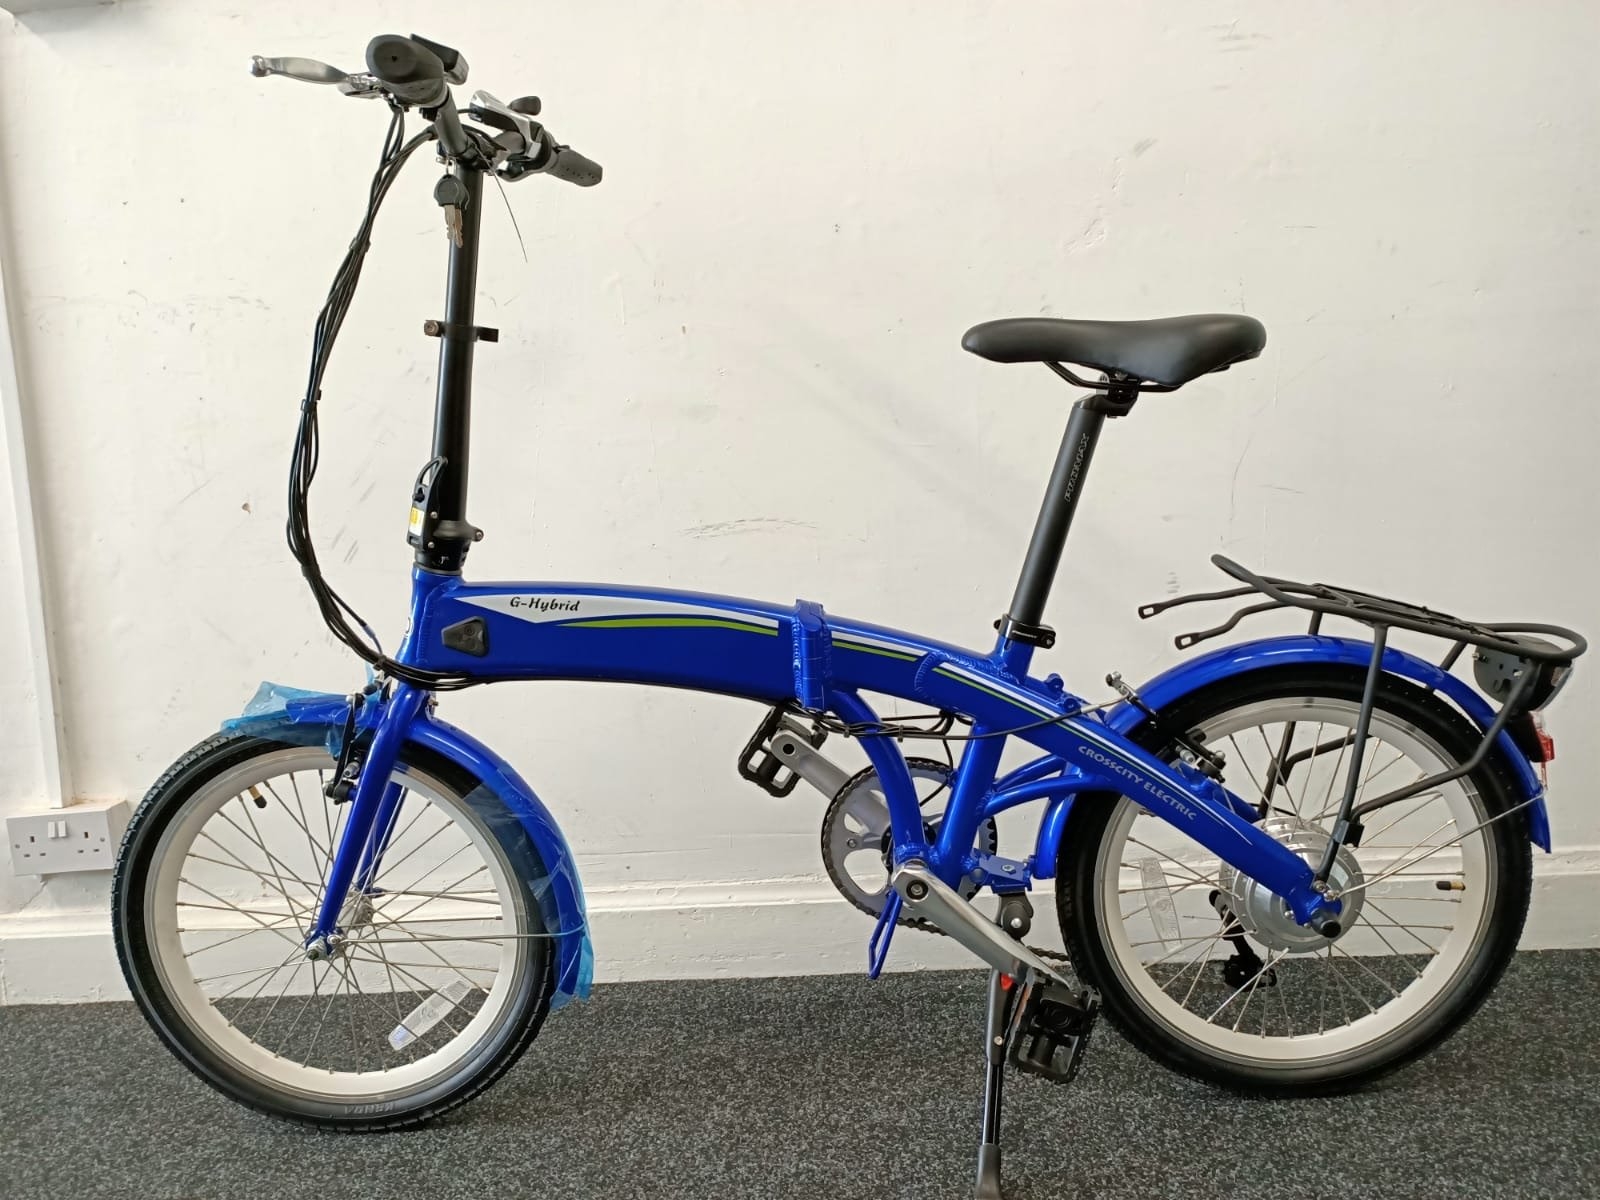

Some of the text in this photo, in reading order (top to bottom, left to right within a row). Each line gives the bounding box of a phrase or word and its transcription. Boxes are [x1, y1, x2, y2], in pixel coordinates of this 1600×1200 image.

[510, 596, 580, 612] G-Hybrid
[1078, 746, 1197, 820] CROSSCITY ELECTRIC
